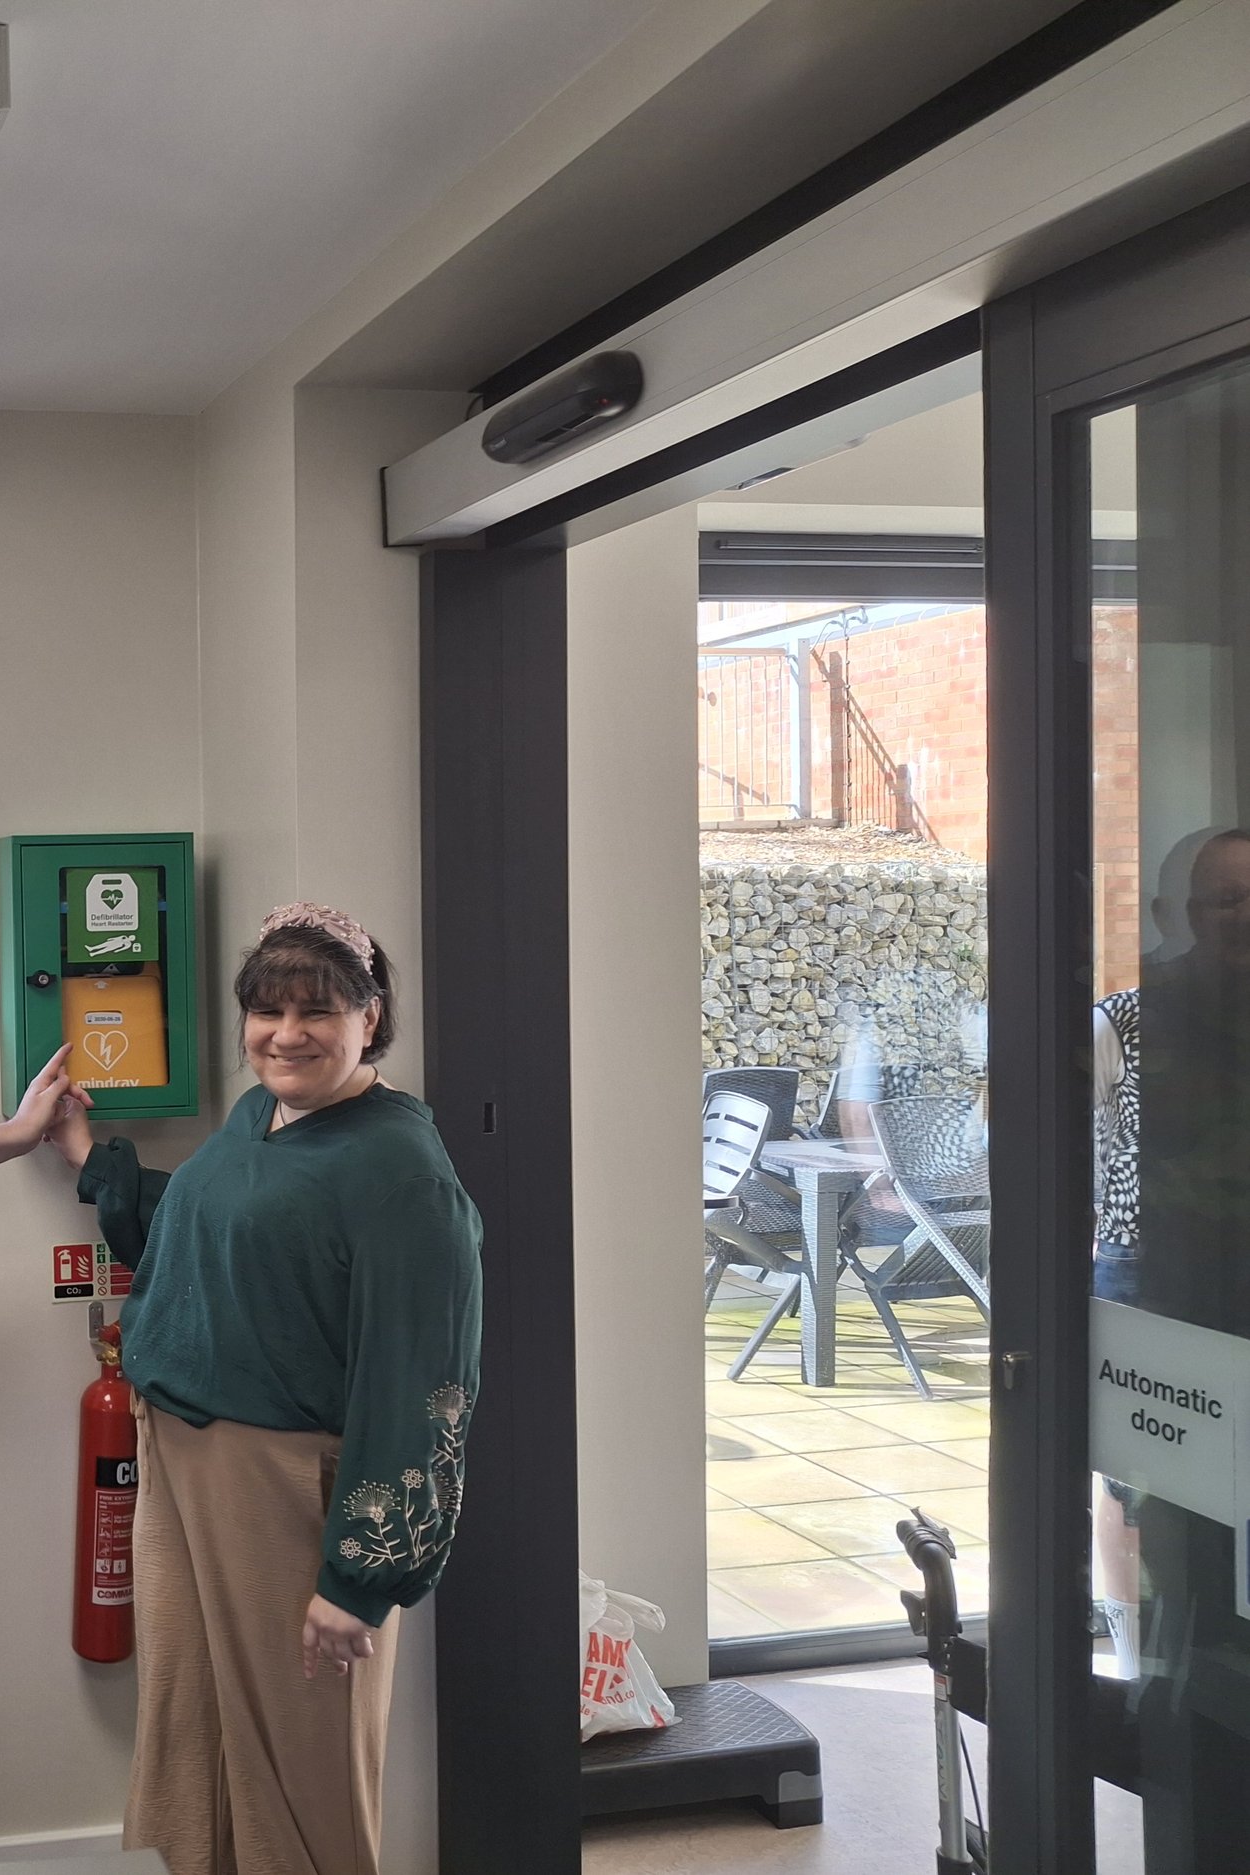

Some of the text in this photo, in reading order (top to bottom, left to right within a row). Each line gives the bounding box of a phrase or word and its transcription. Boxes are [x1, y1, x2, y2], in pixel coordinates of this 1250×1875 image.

[77, 1077, 140, 1088] mindray
[1099, 1359, 1223, 1419] Automatic
[1131, 1408, 1187, 1445] door
